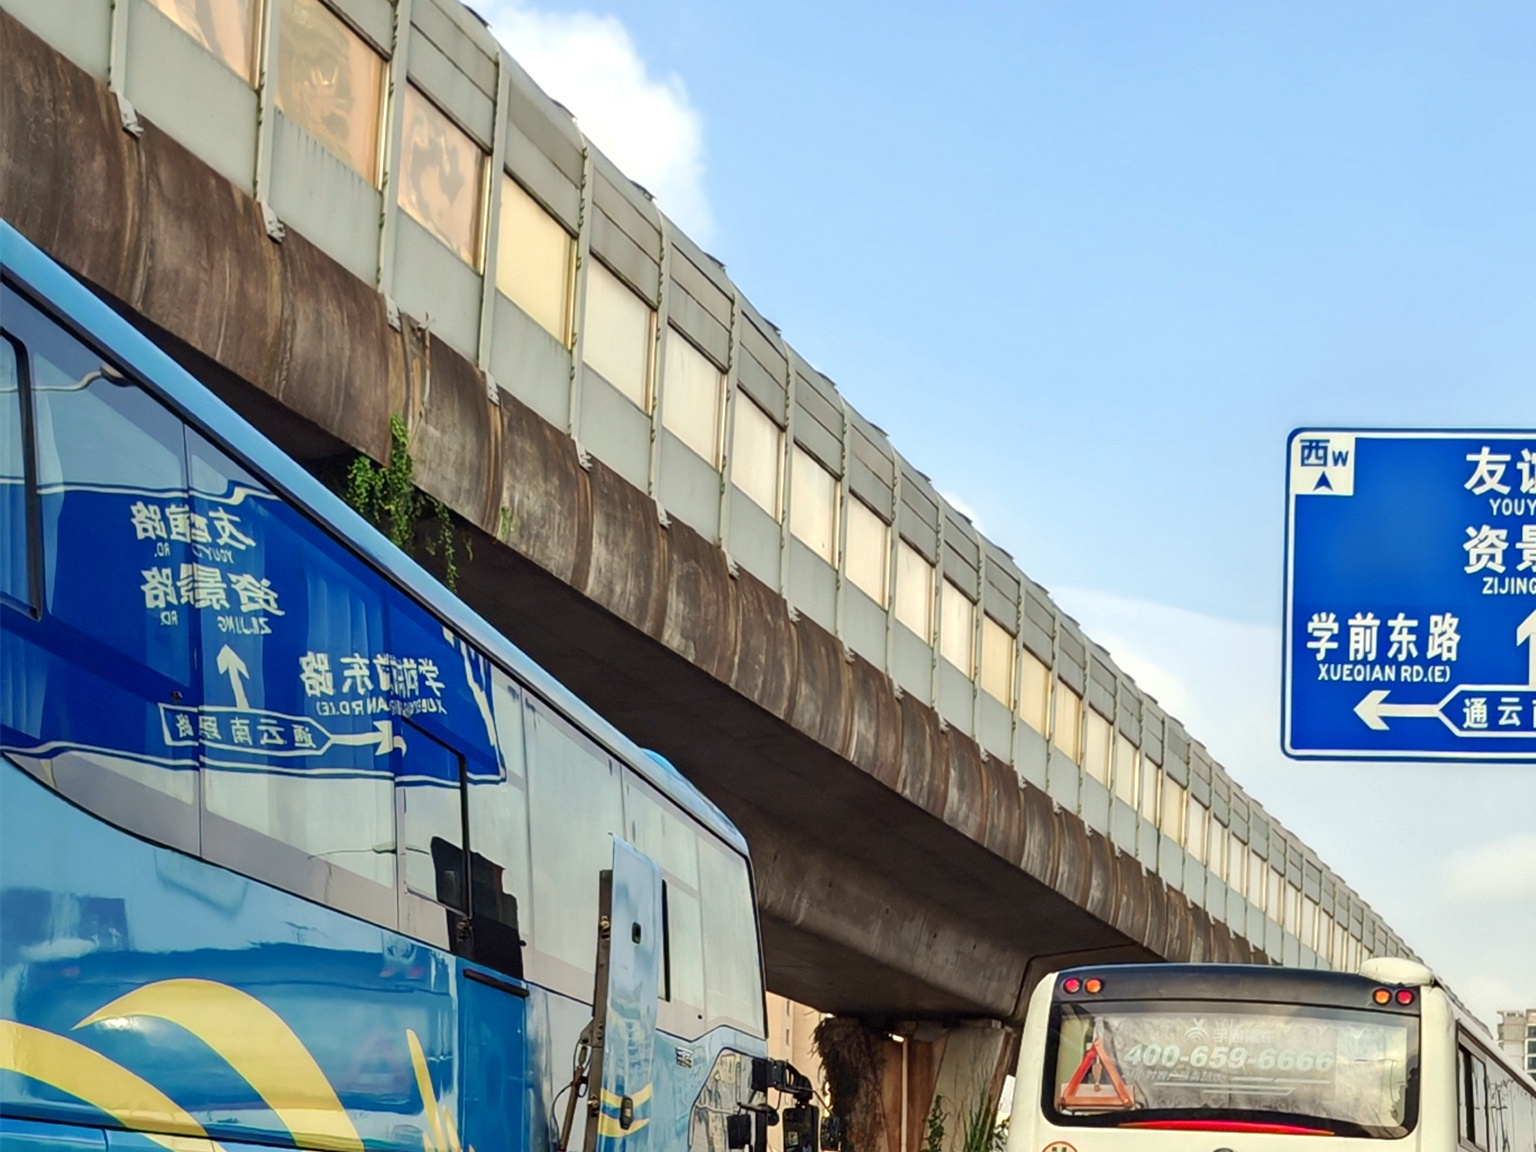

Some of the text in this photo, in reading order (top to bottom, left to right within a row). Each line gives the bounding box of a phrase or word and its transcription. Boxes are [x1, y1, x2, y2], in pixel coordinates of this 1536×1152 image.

[1300, 439, 1349, 467] 西 W
[1306, 612, 1461, 662] 学前东路
[1317, 664, 1451, 684] XUEQIAN RD.(E)
[1124, 1043, 1334, 1072] 400-659-6666
